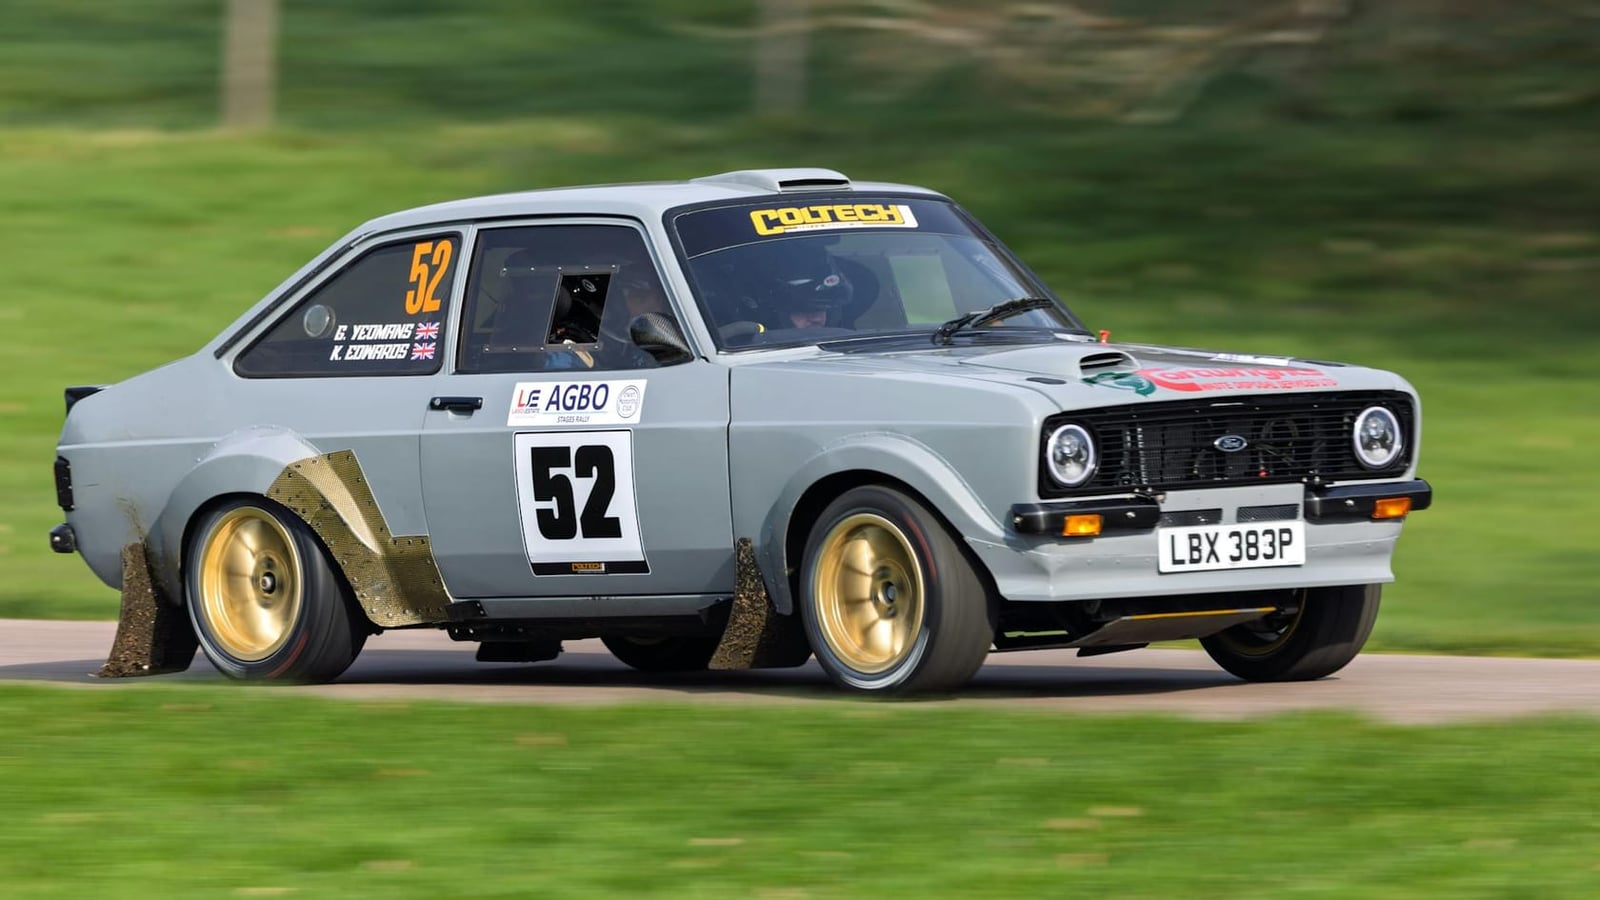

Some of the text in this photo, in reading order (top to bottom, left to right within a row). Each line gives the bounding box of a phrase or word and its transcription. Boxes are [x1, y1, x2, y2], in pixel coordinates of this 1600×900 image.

[750, 204, 905, 236] COLTECH
[405, 240, 453, 315] 52
[333, 323, 415, 341] G. YEOMANS
[329, 343, 411, 361] K. EDWARDS
[545, 384, 609, 411] AGBO
[556, 415, 575, 424] STAGES
[531, 445, 622, 540] 52
[1171, 528, 1293, 565] LBX 383P
